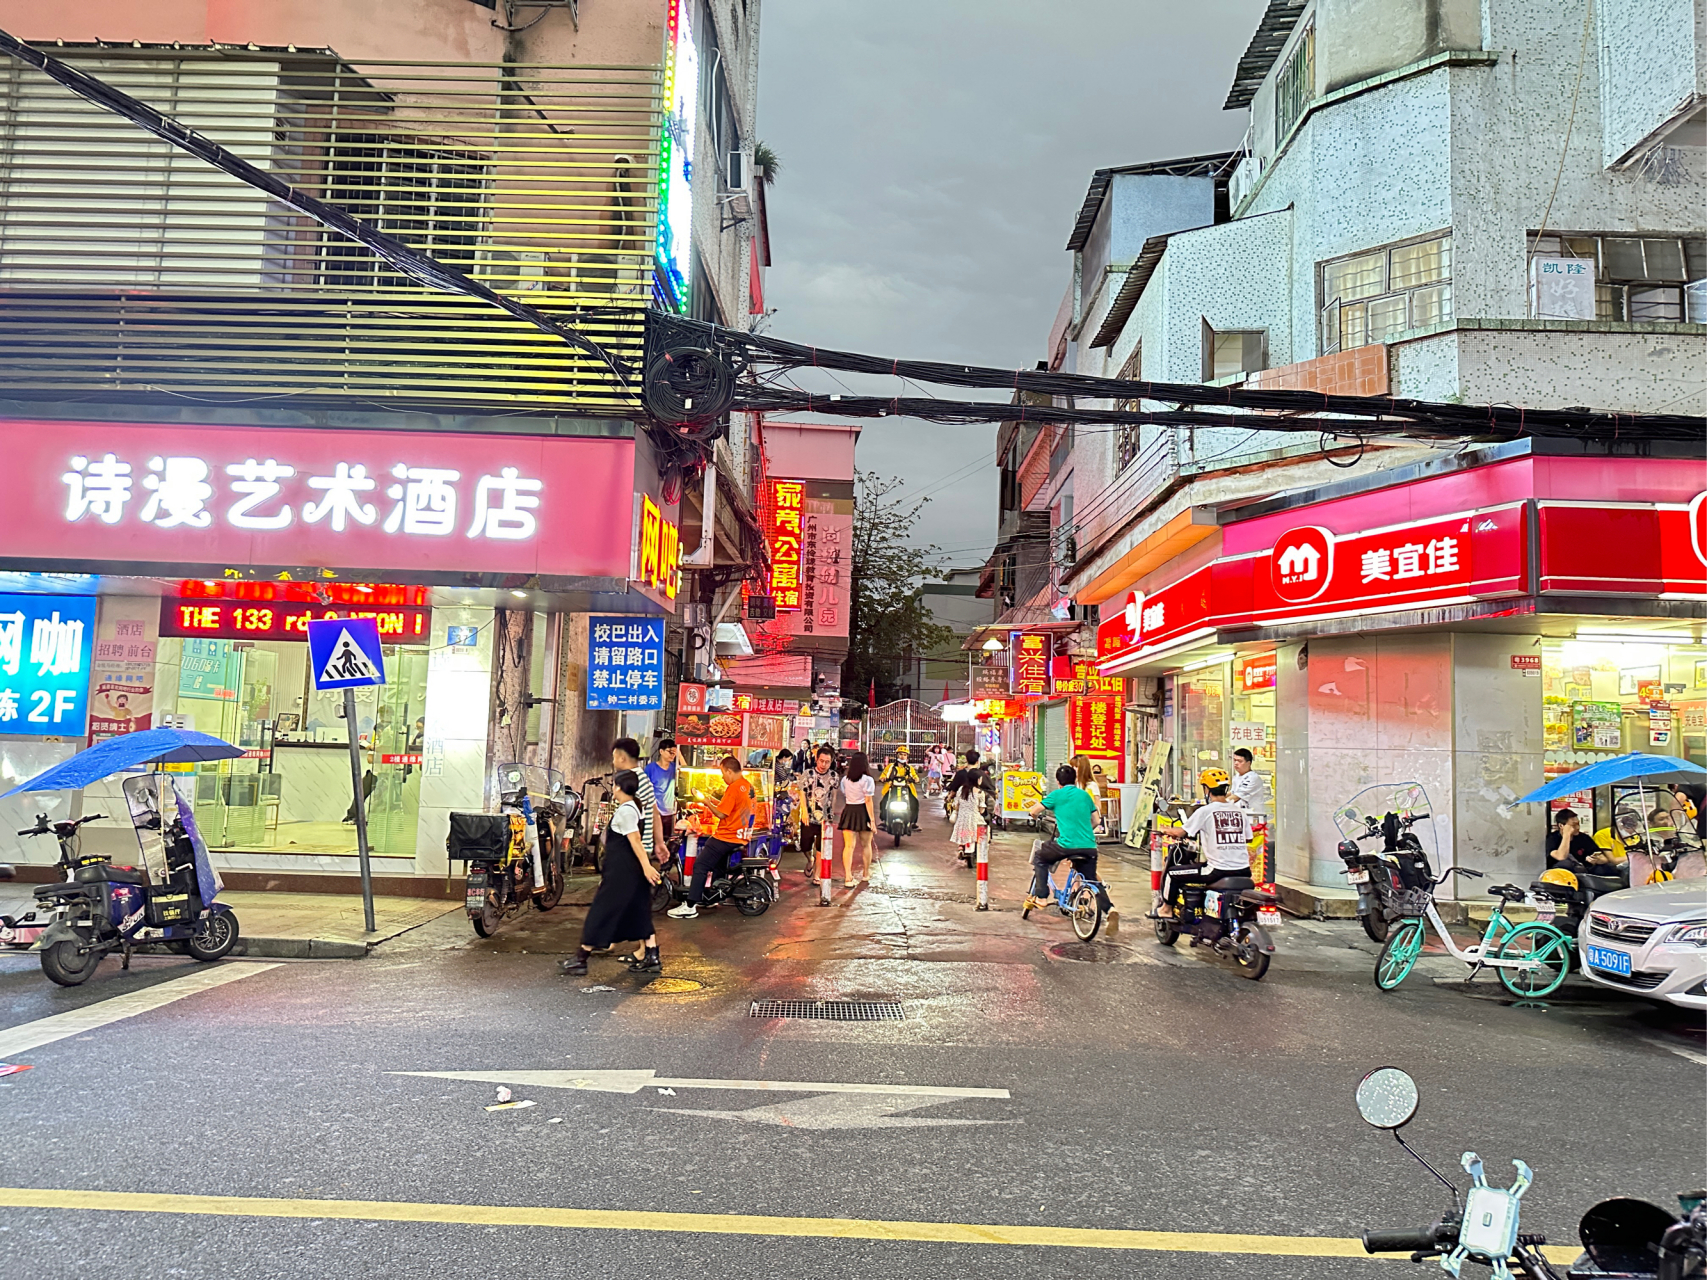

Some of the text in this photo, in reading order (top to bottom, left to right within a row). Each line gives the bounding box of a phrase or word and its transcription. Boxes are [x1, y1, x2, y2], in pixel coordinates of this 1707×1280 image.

[1542, 262, 1587, 274] 凯隆
[62, 452, 543, 540] 诗漫艺术酒店
[641, 492, 679, 600] 网吧
[1360, 537, 1460, 584] 美宜佳
[772, 590, 799, 606] 住宿
[180, 606, 221, 628] THE
[233, 608, 273, 630] 133
[285, 610, 312, 631] rd
[116, 623, 144, 637] 酒店
[594, 624, 660, 643] 校巴出入
[98, 643, 152, 658] 招聘 前台
[593, 647, 658, 666] 请留路口
[1018, 635, 1047, 694] 富兴住宿
[593, 669, 659, 689] 禁止停车
[28, 690, 77, 723] 2F
[607, 694, 659, 705] 钟二村委示
[1230, 726, 1265, 741] 充电宝
